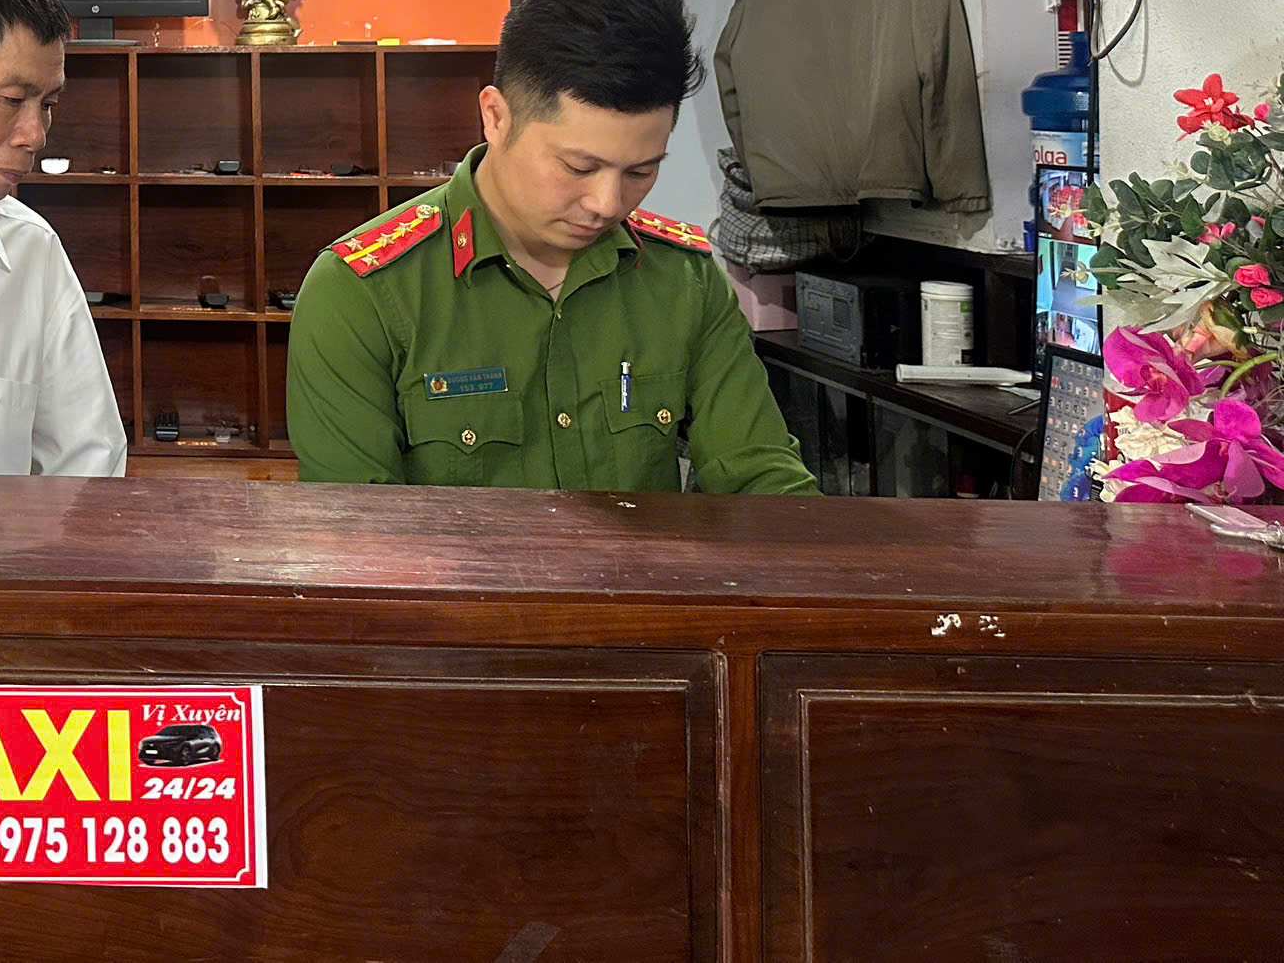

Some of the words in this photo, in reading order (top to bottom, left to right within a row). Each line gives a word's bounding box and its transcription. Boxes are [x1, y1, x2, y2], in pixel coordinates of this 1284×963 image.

[1032, 145, 1067, 165] olga
[142, 704, 166, 726] Vị
[171, 703, 241, 726] Xuyên
[141, 778, 236, 800] 24/24
[83, 816, 148, 864] 128
[162, 816, 229, 863] 883
